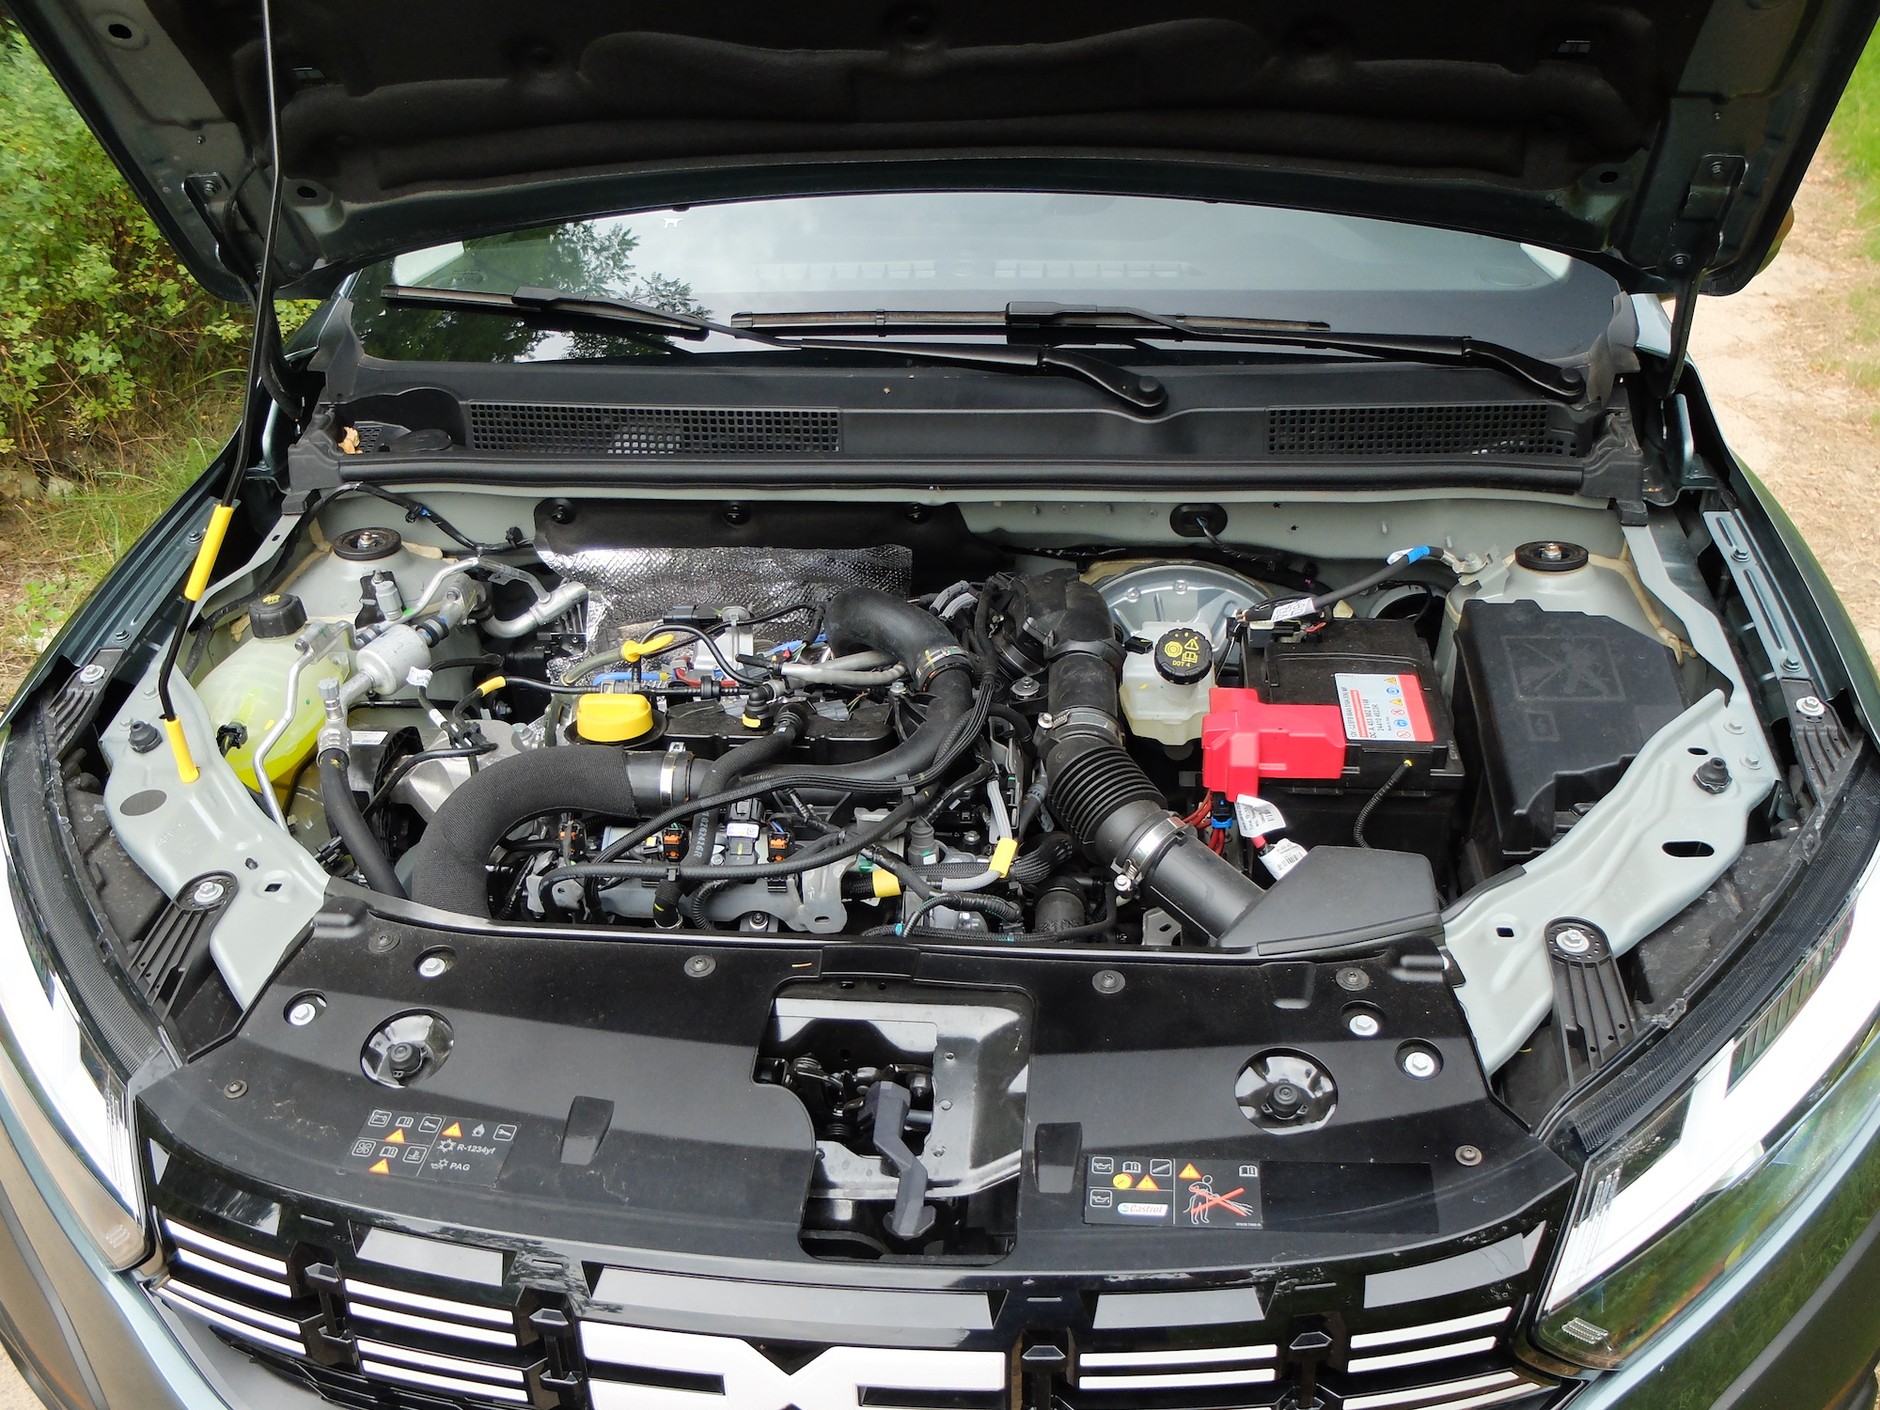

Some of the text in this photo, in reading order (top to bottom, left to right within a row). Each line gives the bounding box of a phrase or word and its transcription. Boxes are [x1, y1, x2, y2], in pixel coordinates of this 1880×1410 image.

[457, 1143, 496, 1155] R-1234yf
[449, 1162, 471, 1172] PAG
[1129, 1204, 1164, 1214] Castrol
